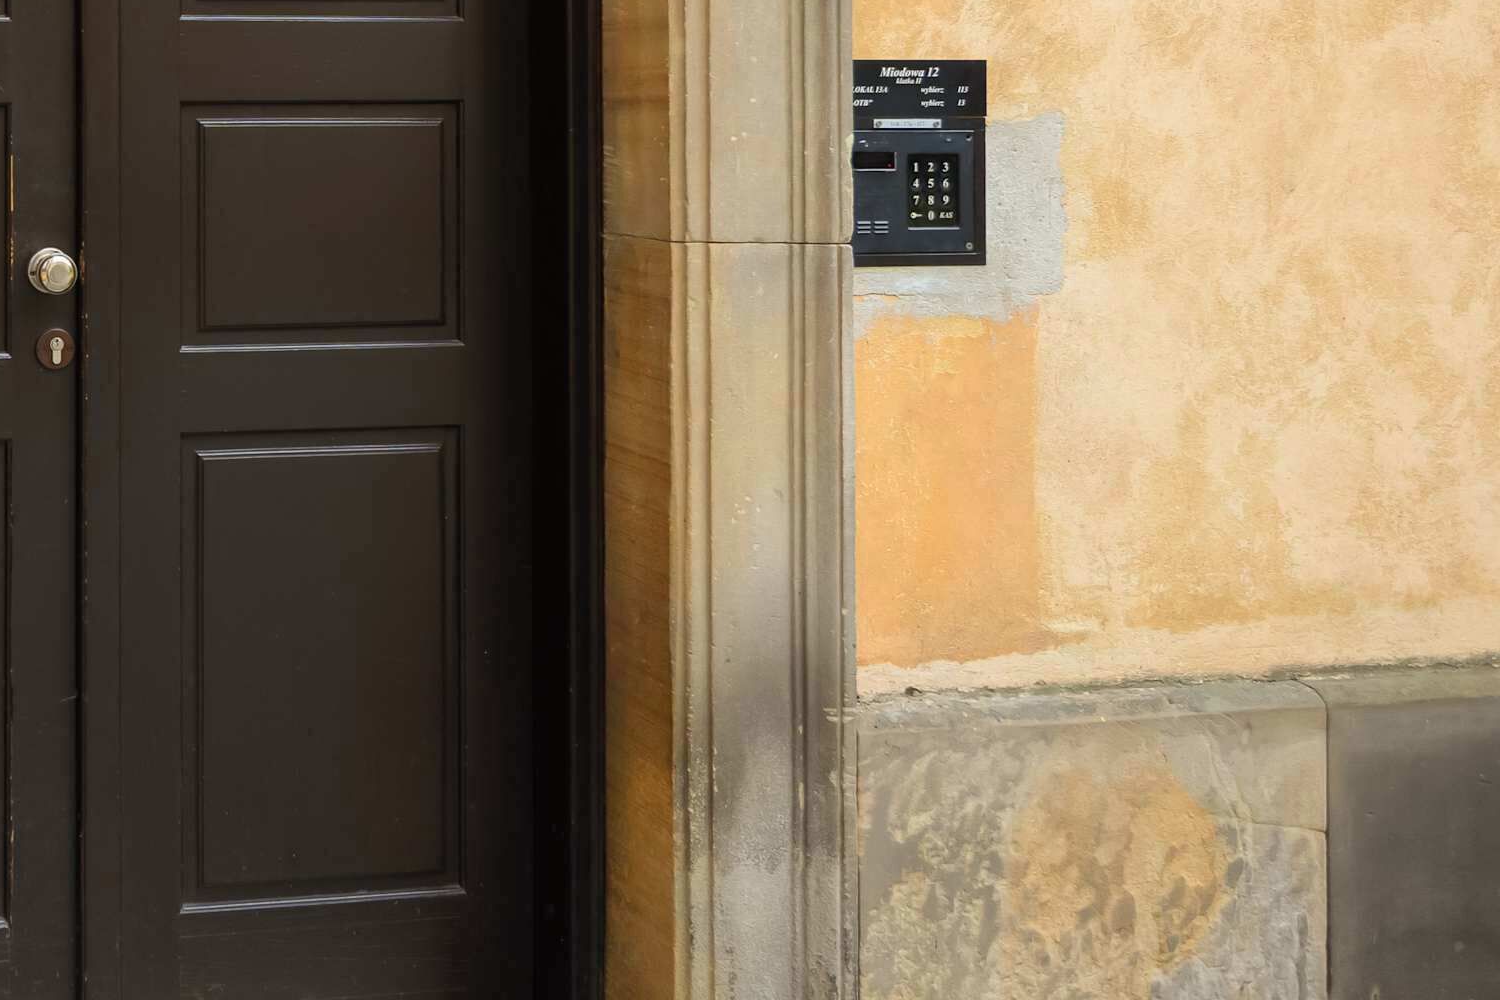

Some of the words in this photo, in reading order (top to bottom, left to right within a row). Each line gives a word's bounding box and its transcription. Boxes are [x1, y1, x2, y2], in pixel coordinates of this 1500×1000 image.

[880, 67, 925, 78] Miodowa
[927, 67, 940, 78] 12
[920, 86, 945, 95] wybierz
[920, 99, 945, 108] wybierz
[913, 162, 919, 172] 1
[927, 162, 934, 172] 2
[942, 162, 949, 172] 3
[913, 178, 919, 188] 4
[927, 178, 934, 188] 5
[942, 178, 949, 188] 6
[913, 195, 919, 205] 7
[927, 195, 934, 205] 8
[942, 195, 949, 205] 9
[927, 210, 935, 220] 0
